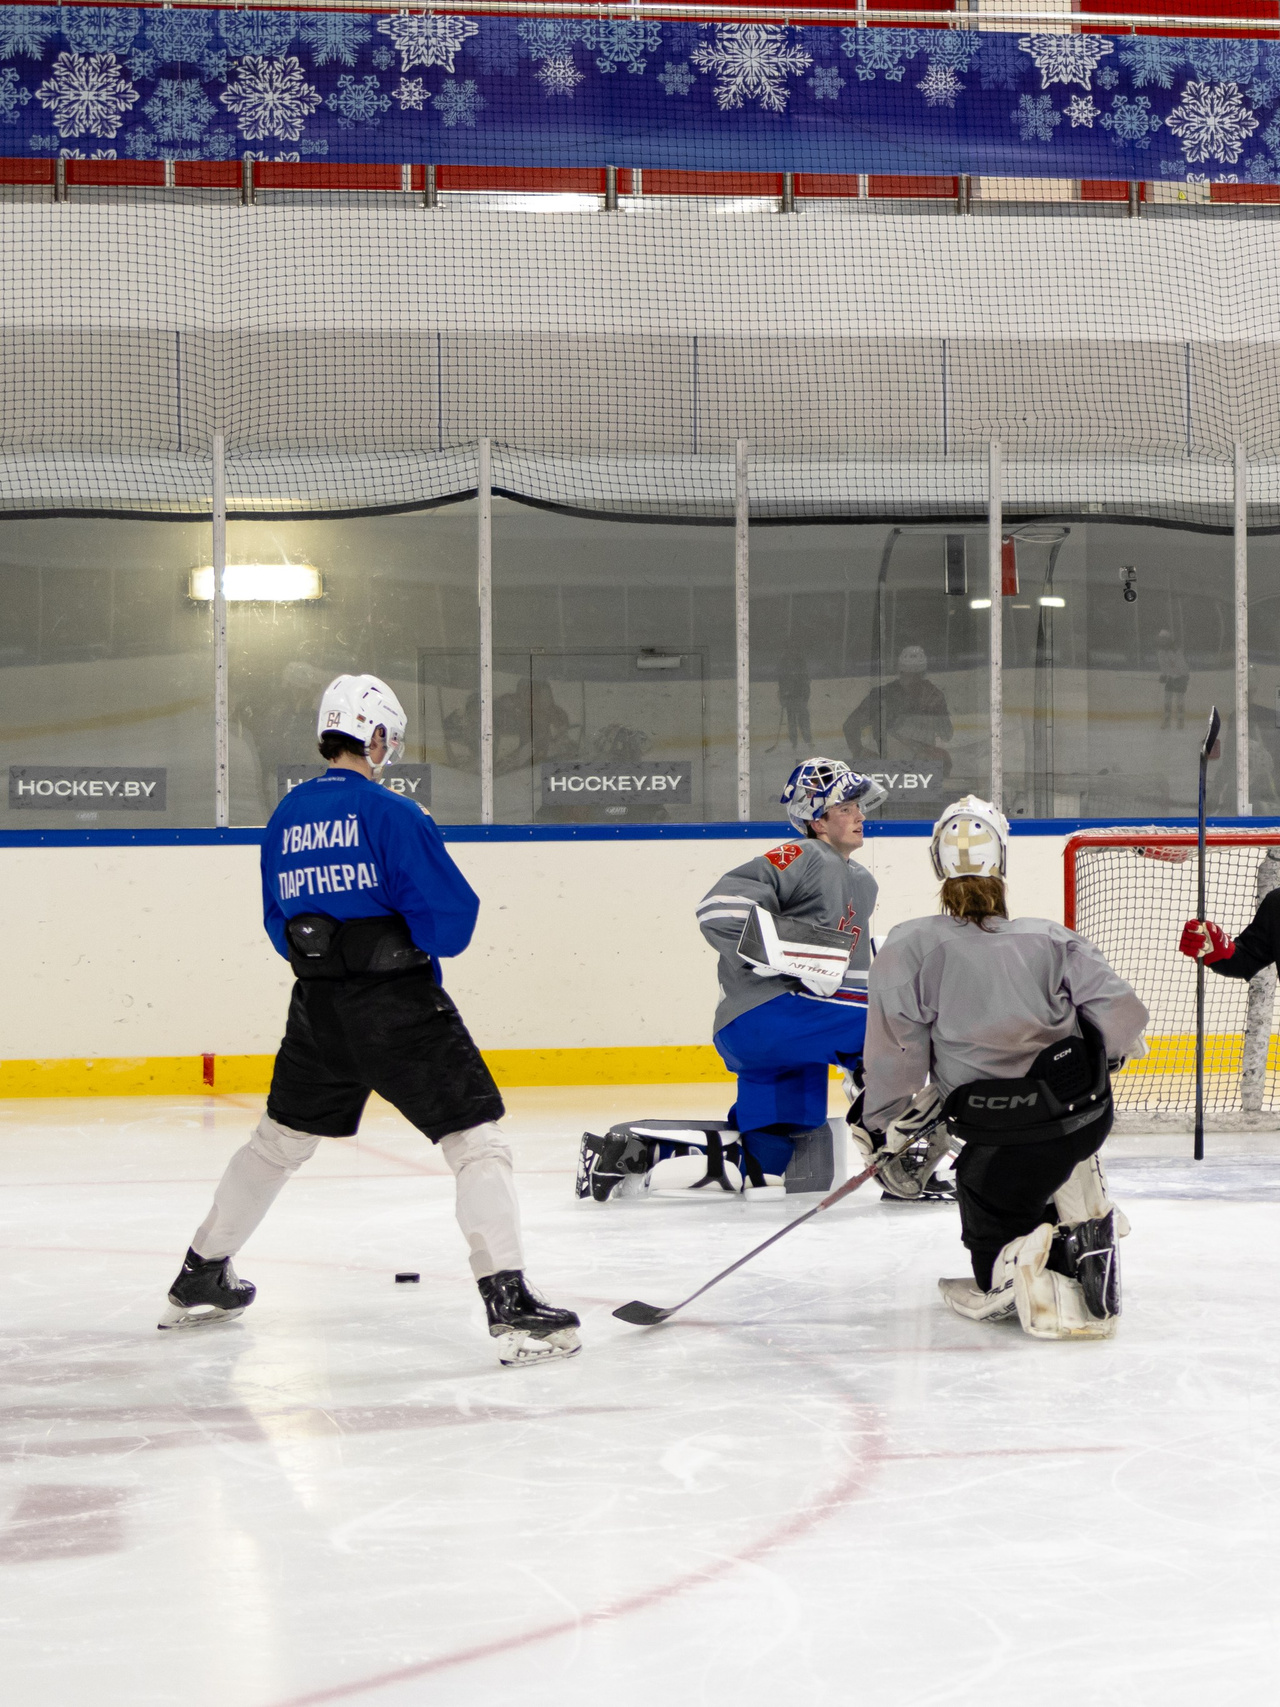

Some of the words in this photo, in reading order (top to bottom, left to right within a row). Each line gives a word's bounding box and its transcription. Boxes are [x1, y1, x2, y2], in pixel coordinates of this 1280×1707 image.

[326, 712, 341, 728] 64
[18, 780, 157, 797] HOCKEY.BY
[550, 775, 682, 792] HOCKEY.BY
[868, 773, 933, 789] EY.BY
[281, 813, 360, 855] УВАЖАЙ
[278, 862, 379, 900] ПАРТНЕРА!
[1053, 1048, 1072, 1061] CCM
[968, 1092, 1038, 1110] CCM
